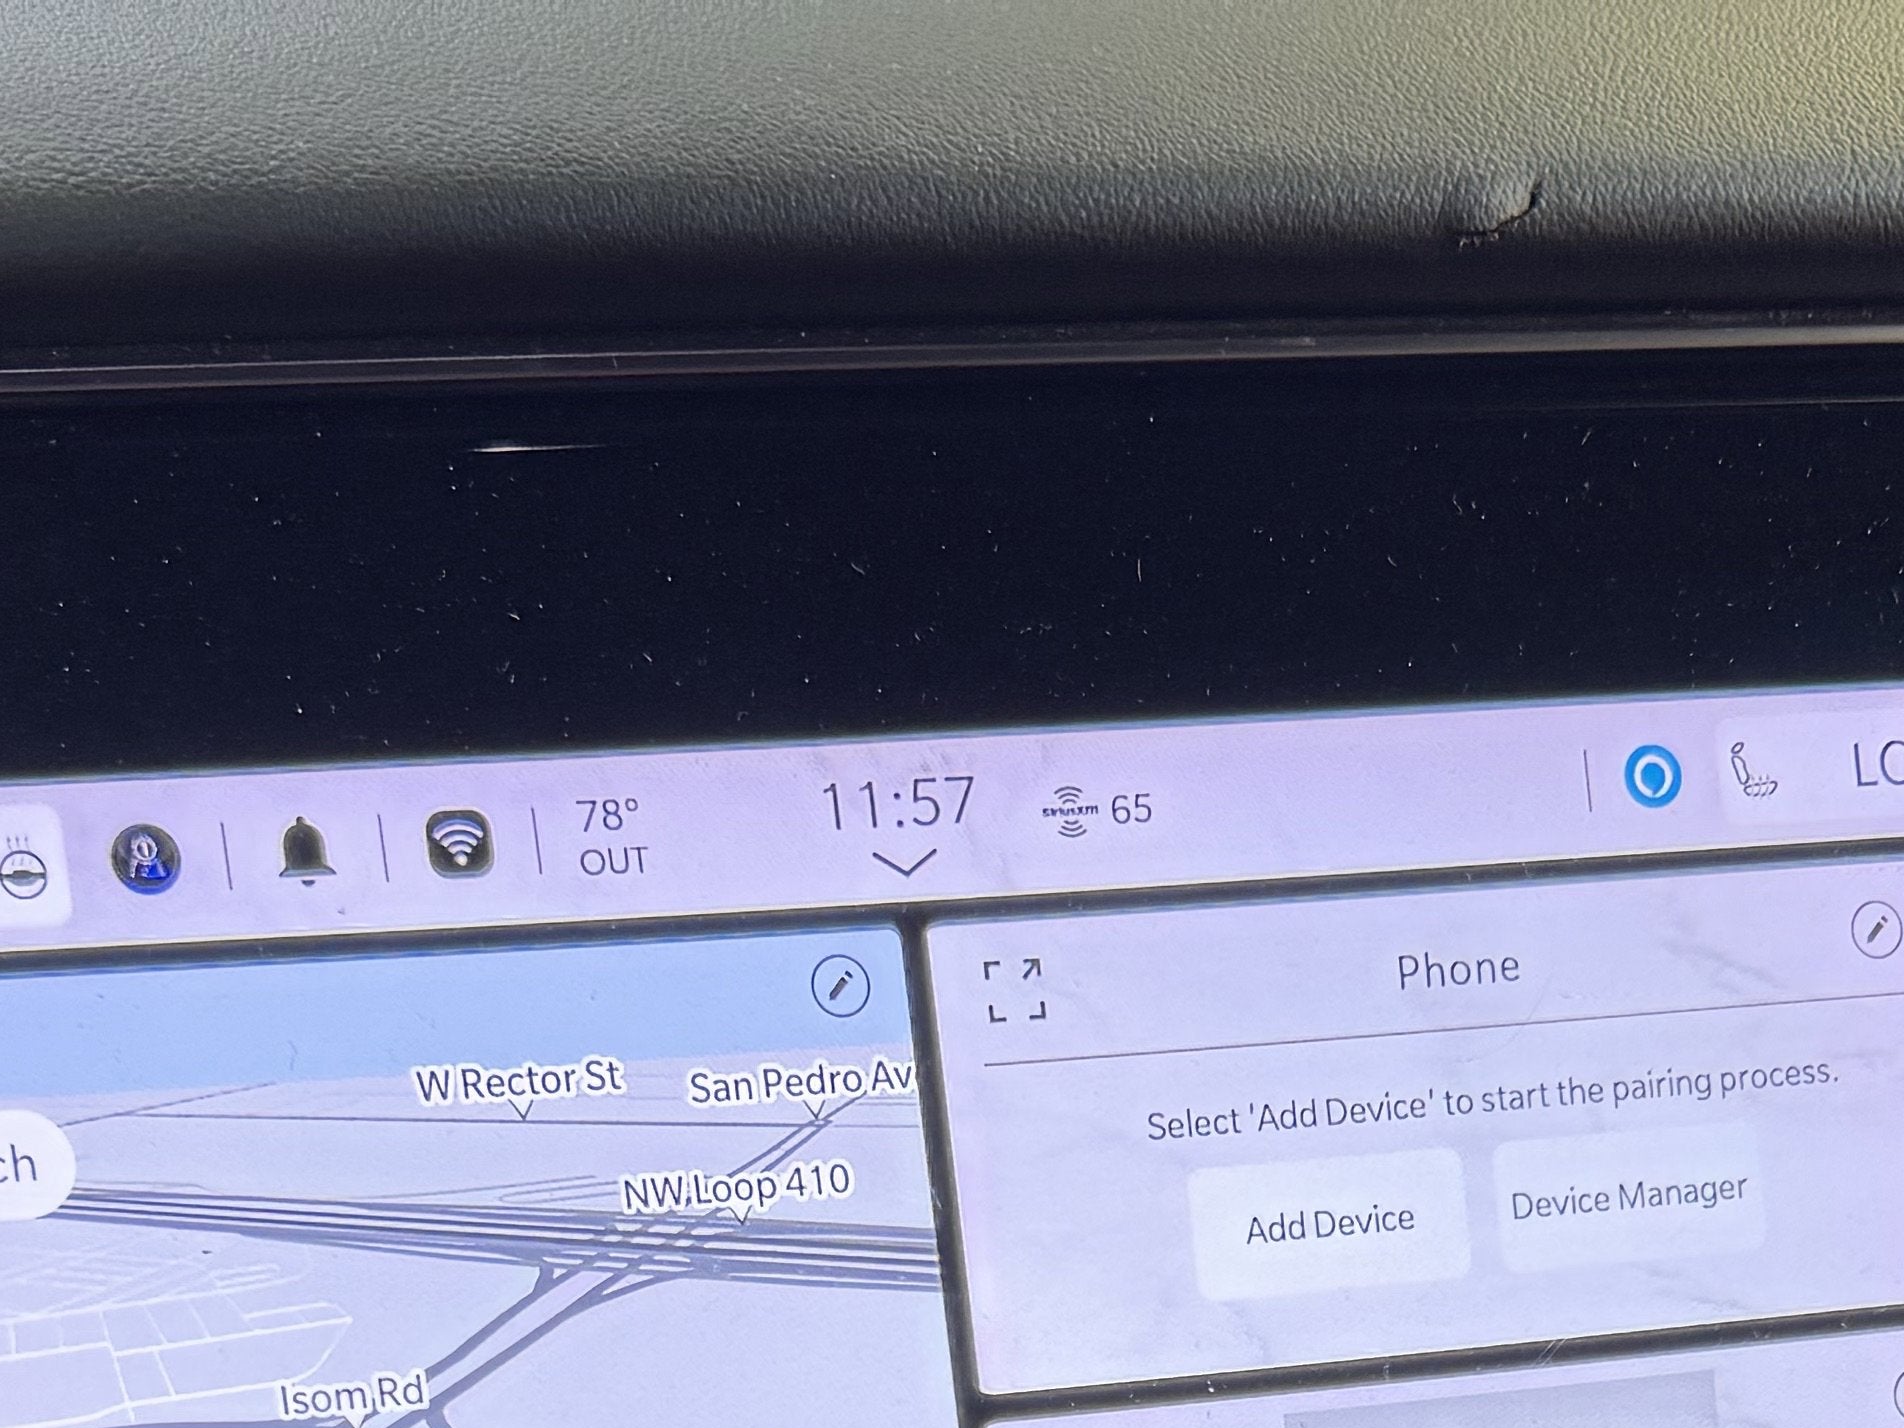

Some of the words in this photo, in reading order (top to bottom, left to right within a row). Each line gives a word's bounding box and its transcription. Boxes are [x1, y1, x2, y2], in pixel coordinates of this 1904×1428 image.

[823, 775, 974, 831] 11:57
[1111, 792, 1152, 825] 65
[580, 846, 649, 876] OUT
[1398, 951, 1520, 991] Phone
[415, 1069, 450, 1102] W
[460, 1066, 577, 1100] Rector
[585, 1060, 622, 1091] St
[690, 1072, 753, 1104] San
[762, 1063, 862, 1099] Pedro
[871, 1060, 912, 1092] Av
[1147, 1108, 1242, 1141] Select
[1249, 1098, 1317, 1132] 'Add
[1325, 1088, 1433, 1126] Device'
[1444, 1090, 1474, 1116] to
[1481, 1082, 1550, 1113] start
[1557, 1076, 1604, 1106] the
[1613, 1067, 1712, 1109] pairing
[1720, 1063, 1839, 1100] process.
[624, 1175, 683, 1210] NW
[693, 1174, 777, 1208] Loop
[785, 1163, 850, 1197] 410
[1512, 1186, 1610, 1220] Device
[1618, 1178, 1748, 1211] Manager
[1246, 1210, 1306, 1245] Add
[1314, 1204, 1415, 1239] Device
[280, 1385, 368, 1416] Isom
[377, 1373, 424, 1408] Rd
